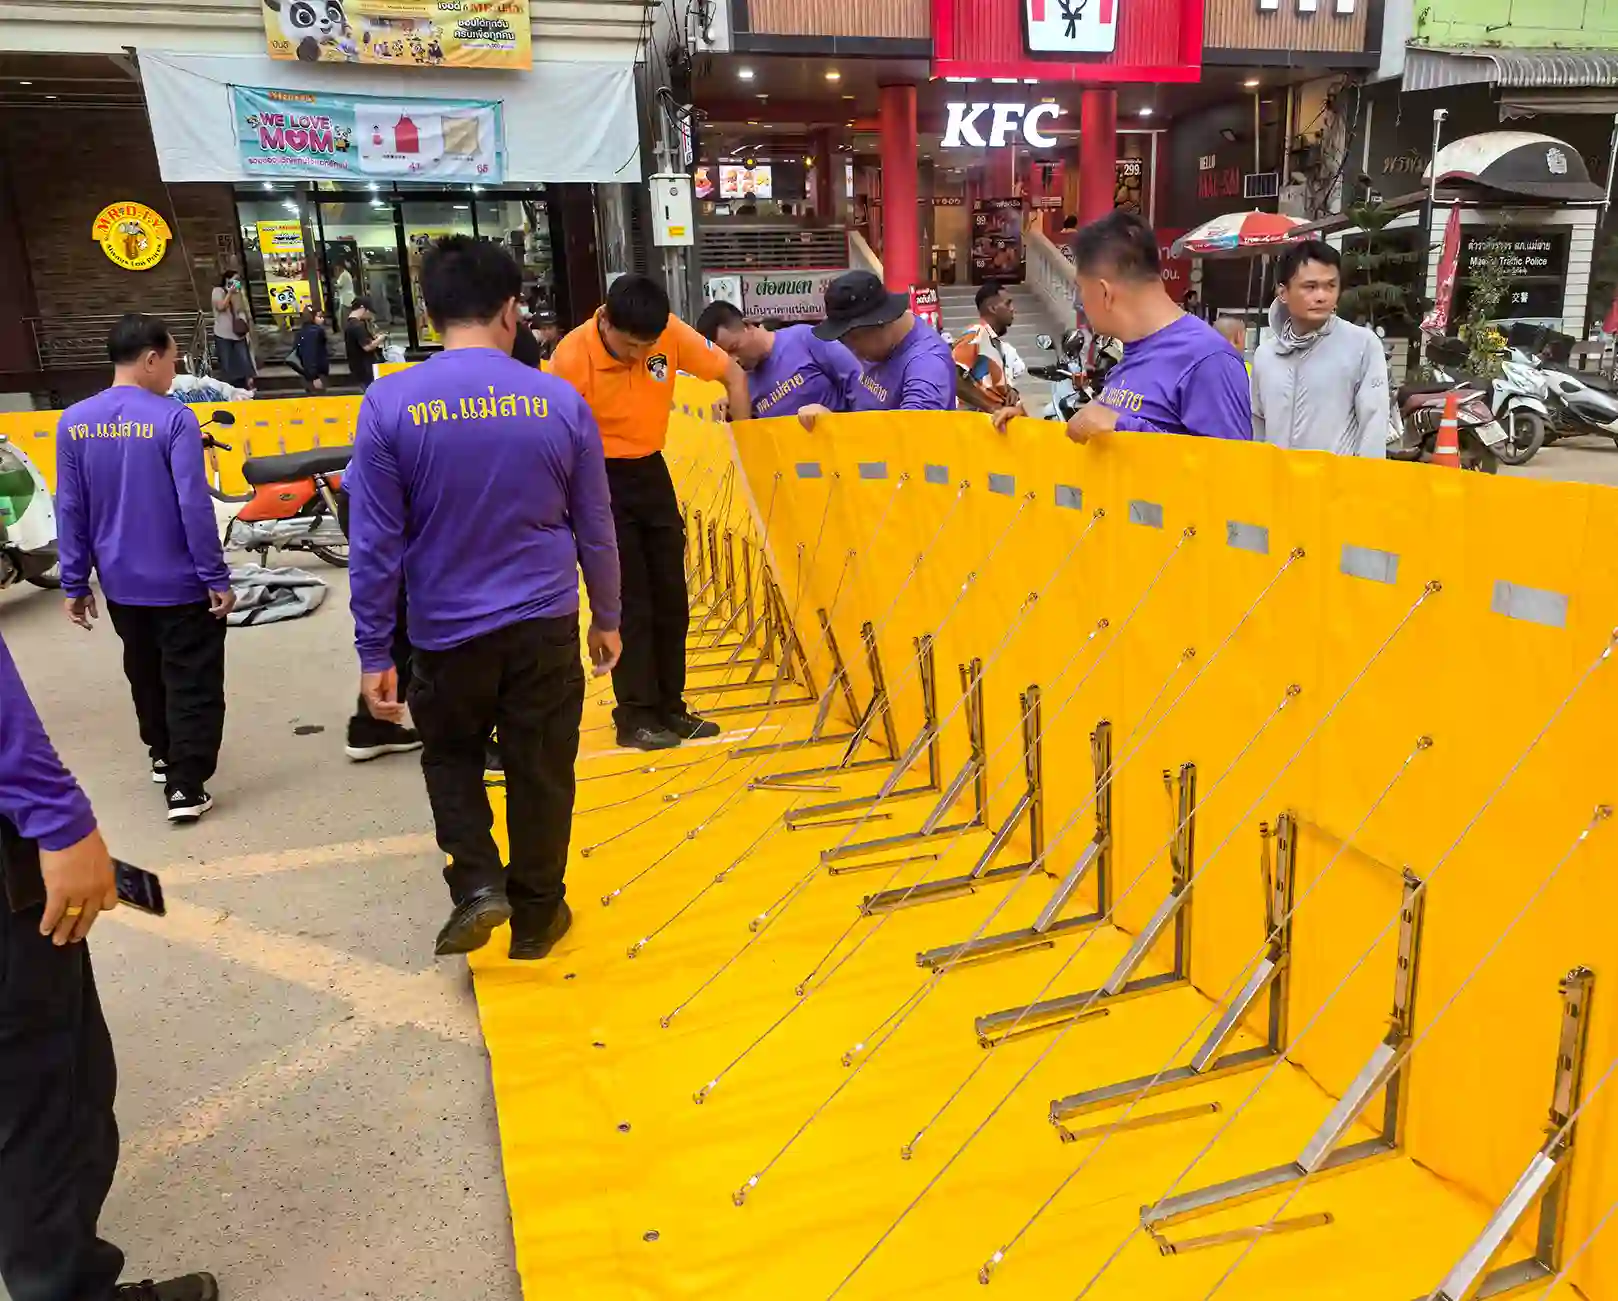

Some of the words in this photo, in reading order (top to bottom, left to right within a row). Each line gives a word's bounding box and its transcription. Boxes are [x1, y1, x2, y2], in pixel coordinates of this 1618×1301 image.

[259, 112, 285, 127] WE
[289, 114, 331, 130] LOVE
[940, 102, 1060, 148] KFC
[1524, 256, 1548, 266] Police
[1160, 268, 1180, 281] ou.
[407, 385, 549, 426] ทต.แม่สาย
